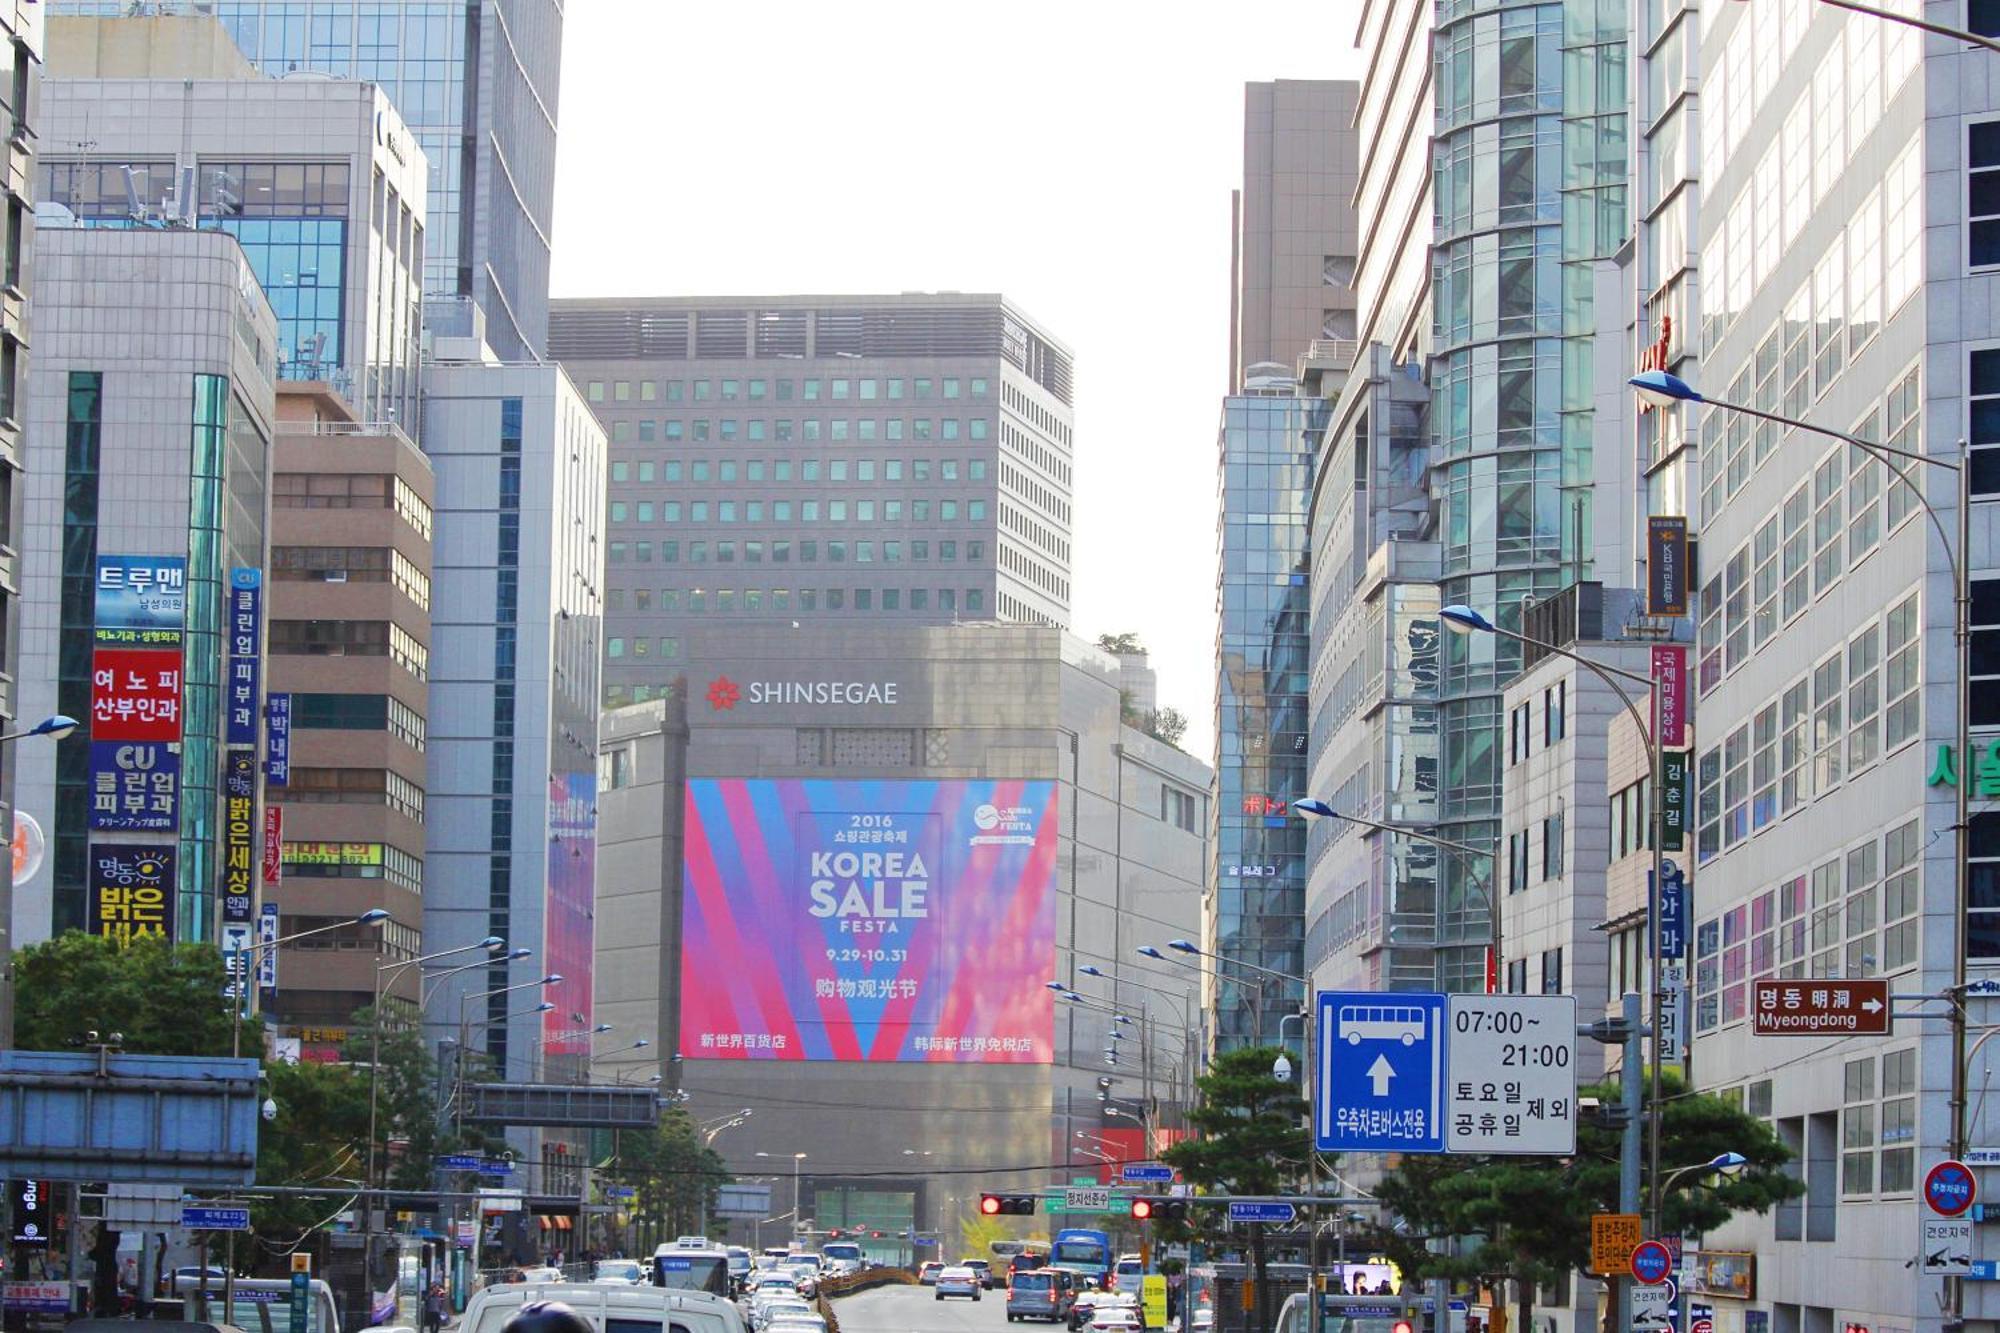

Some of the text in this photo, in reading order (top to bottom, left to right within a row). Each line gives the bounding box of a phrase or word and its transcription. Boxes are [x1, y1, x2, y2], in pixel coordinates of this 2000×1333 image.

[98, 567, 183, 595] 트루맨
[140, 599, 182, 610] 남성의원
[234, 592, 253, 726] 클린업 피부과
[94, 668, 179, 694] 여노피
[750, 682, 897, 704] SHINSEGAE
[1662, 651, 1676, 741] 국제미용상사
[94, 697, 179, 723] 산부인과
[115, 745, 156, 770] CU
[269, 716, 288, 779] 박내과
[95, 771, 175, 793] 클린업
[94, 793, 175, 815] 피부과
[1666, 764, 1681, 826] 김춘길
[851, 815, 893, 828] 2016
[228, 797, 252, 895] 밝은세상
[834, 830, 908, 844] 쇼핑관광축제
[98, 856, 137, 885] 명동
[811, 852, 929, 878] KOREA
[100, 887, 165, 921] 밝은
[808, 879, 928, 918] SALE
[840, 920, 899, 933] FESTA
[826, 949, 908, 962] 9.29-10.31
[815, 978, 918, 999] 购物观光节
[1760, 988, 1850, 1010] 명동 明洞
[1660, 987, 1677, 1060] 한의원
[1760, 1012, 1857, 1029] Myeongdong
[700, 1033, 787, 1050] 新世界百货店
[914, 1036, 1033, 1052] 韩际新世界免税店
[1502, 1044, 1569, 1068] 21:00
[1455, 1081, 1522, 1104] 토요일
[1526, 1098, 1569, 1121] 제외
[1336, 1107, 1426, 1140] 우측차로버스전용
[1455, 1112, 1522, 1137] 공휴일
[1067, 1191, 1108, 1206] 정지선준수
[1932, 1183, 1969, 1195] 주정차금지
[1927, 1226, 1969, 1239] 견인지역
